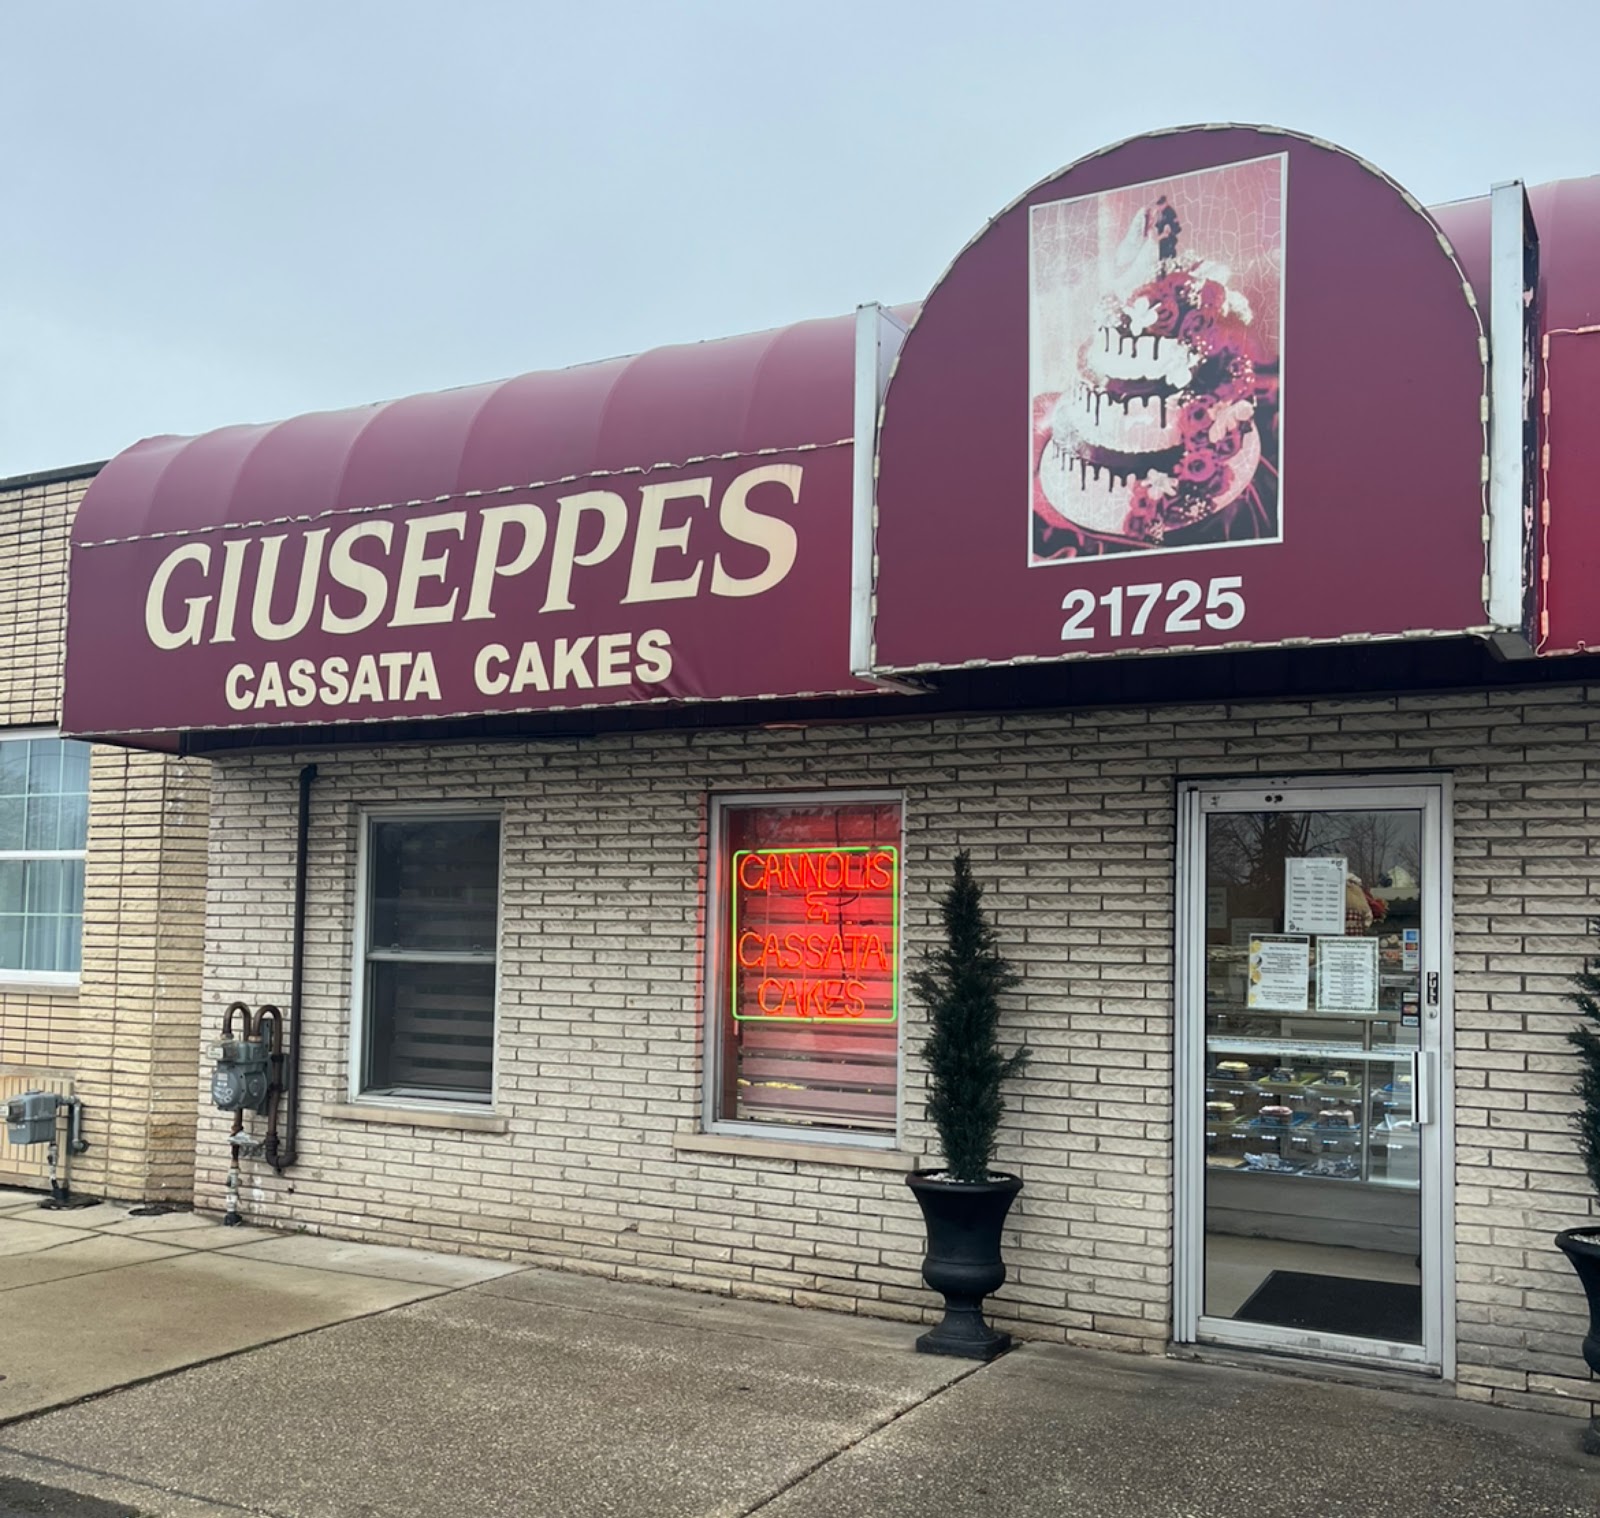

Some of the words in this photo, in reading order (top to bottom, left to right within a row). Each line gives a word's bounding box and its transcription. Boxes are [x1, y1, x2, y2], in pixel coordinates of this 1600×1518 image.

[144, 464, 804, 651] GIUSEPPES
[1061, 576, 1246, 640] 21725
[225, 652, 442, 710] CASSATA
[474, 629, 673, 695] CAKES
[739, 852, 893, 889] CANNOLIS
[739, 932, 889, 970] CASSATA
[758, 977, 868, 1018] CAKES
[1429, 972, 1437, 1004] PULL
